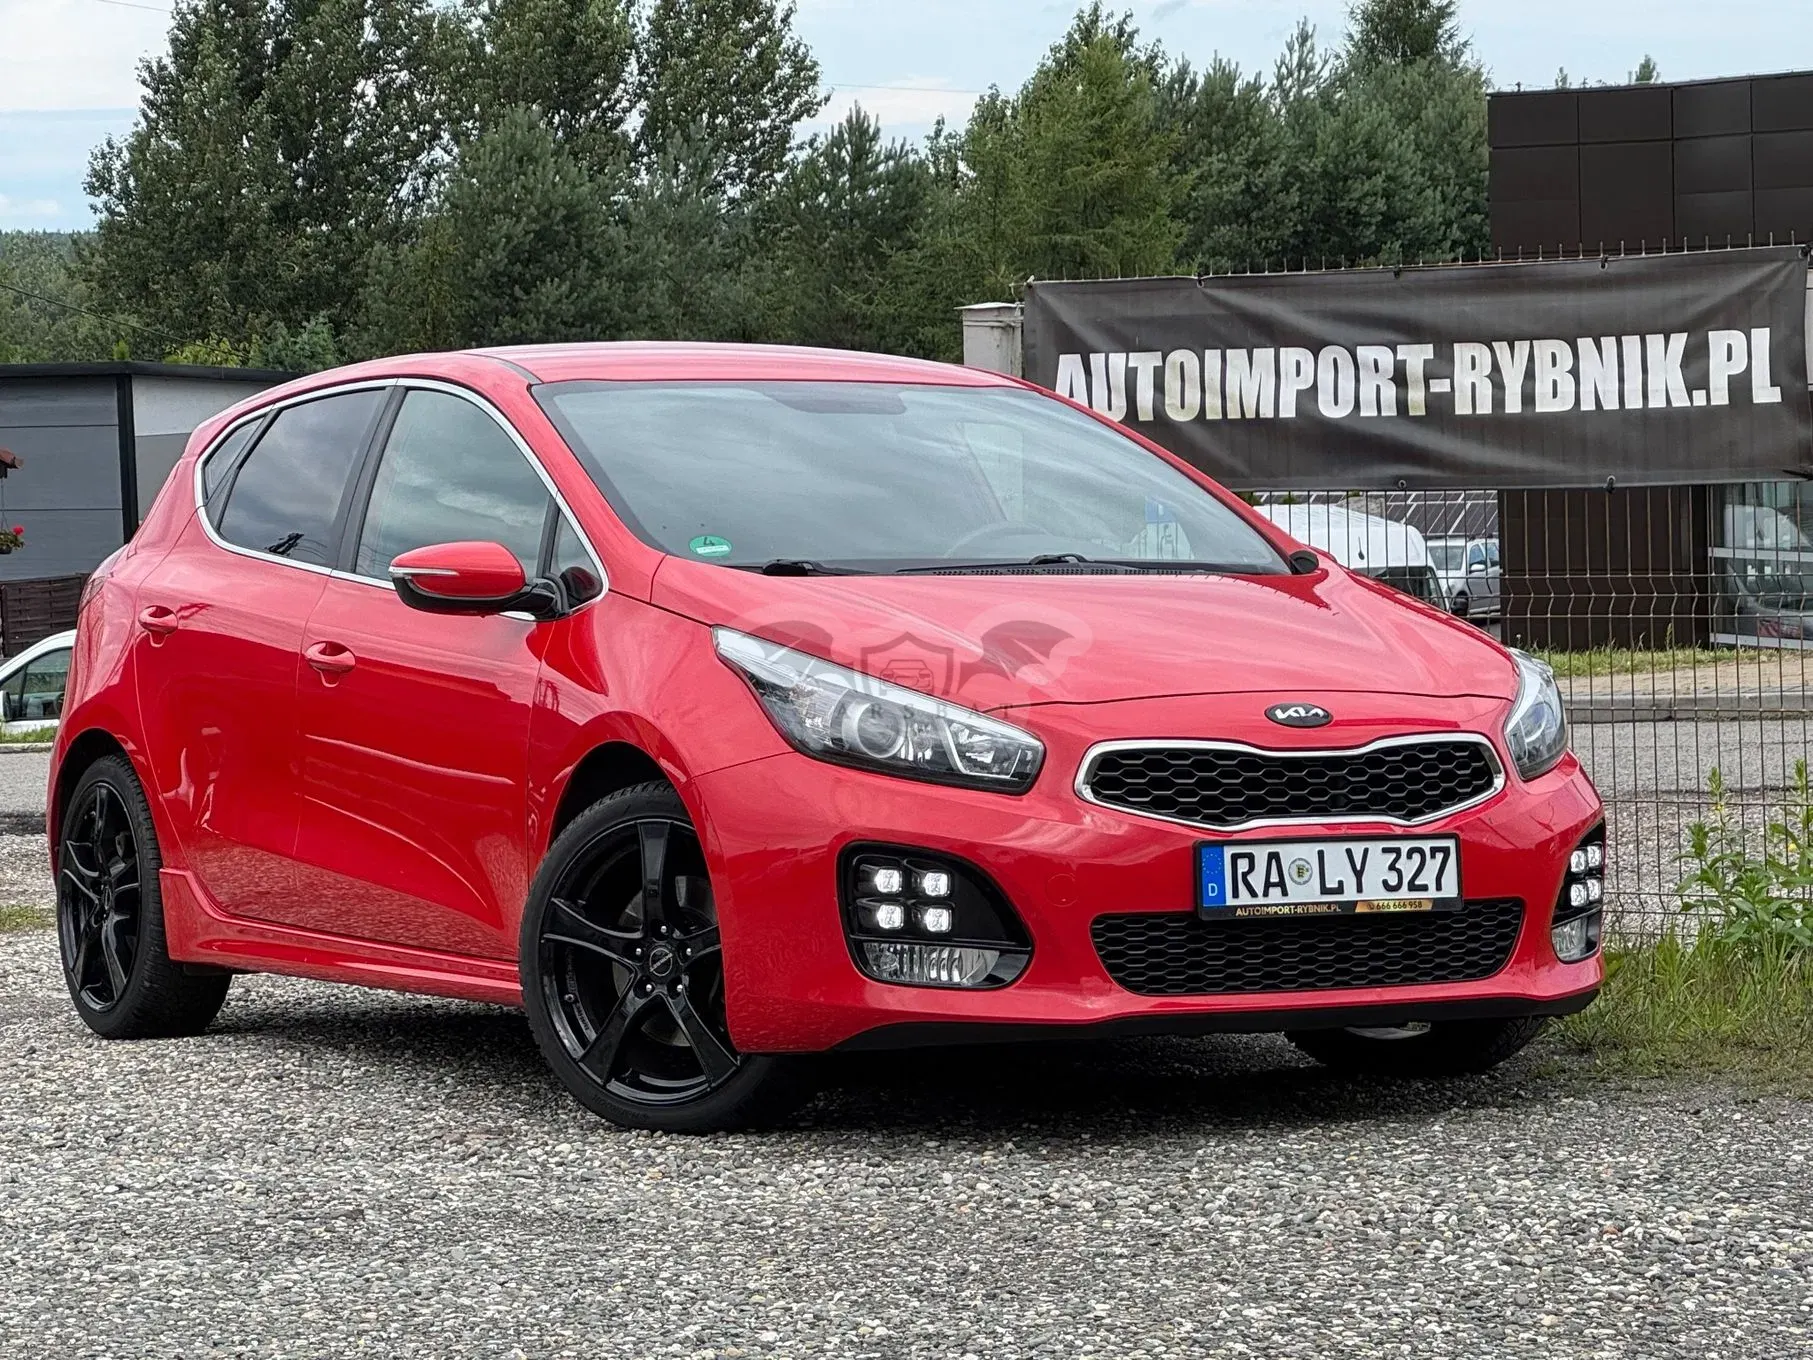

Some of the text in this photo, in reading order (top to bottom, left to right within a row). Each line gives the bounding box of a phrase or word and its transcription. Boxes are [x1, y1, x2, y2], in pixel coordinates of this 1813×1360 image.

[1054, 327, 1783, 423] AUTOIMPORT-RYBNIK.PL
[1274, 706, 1325, 720] KIA
[1208, 845, 1451, 899] D RA LY 327
[1235, 900, 1423, 917] AUTOIMPORT-RYBNIK.PL 666 666 958
